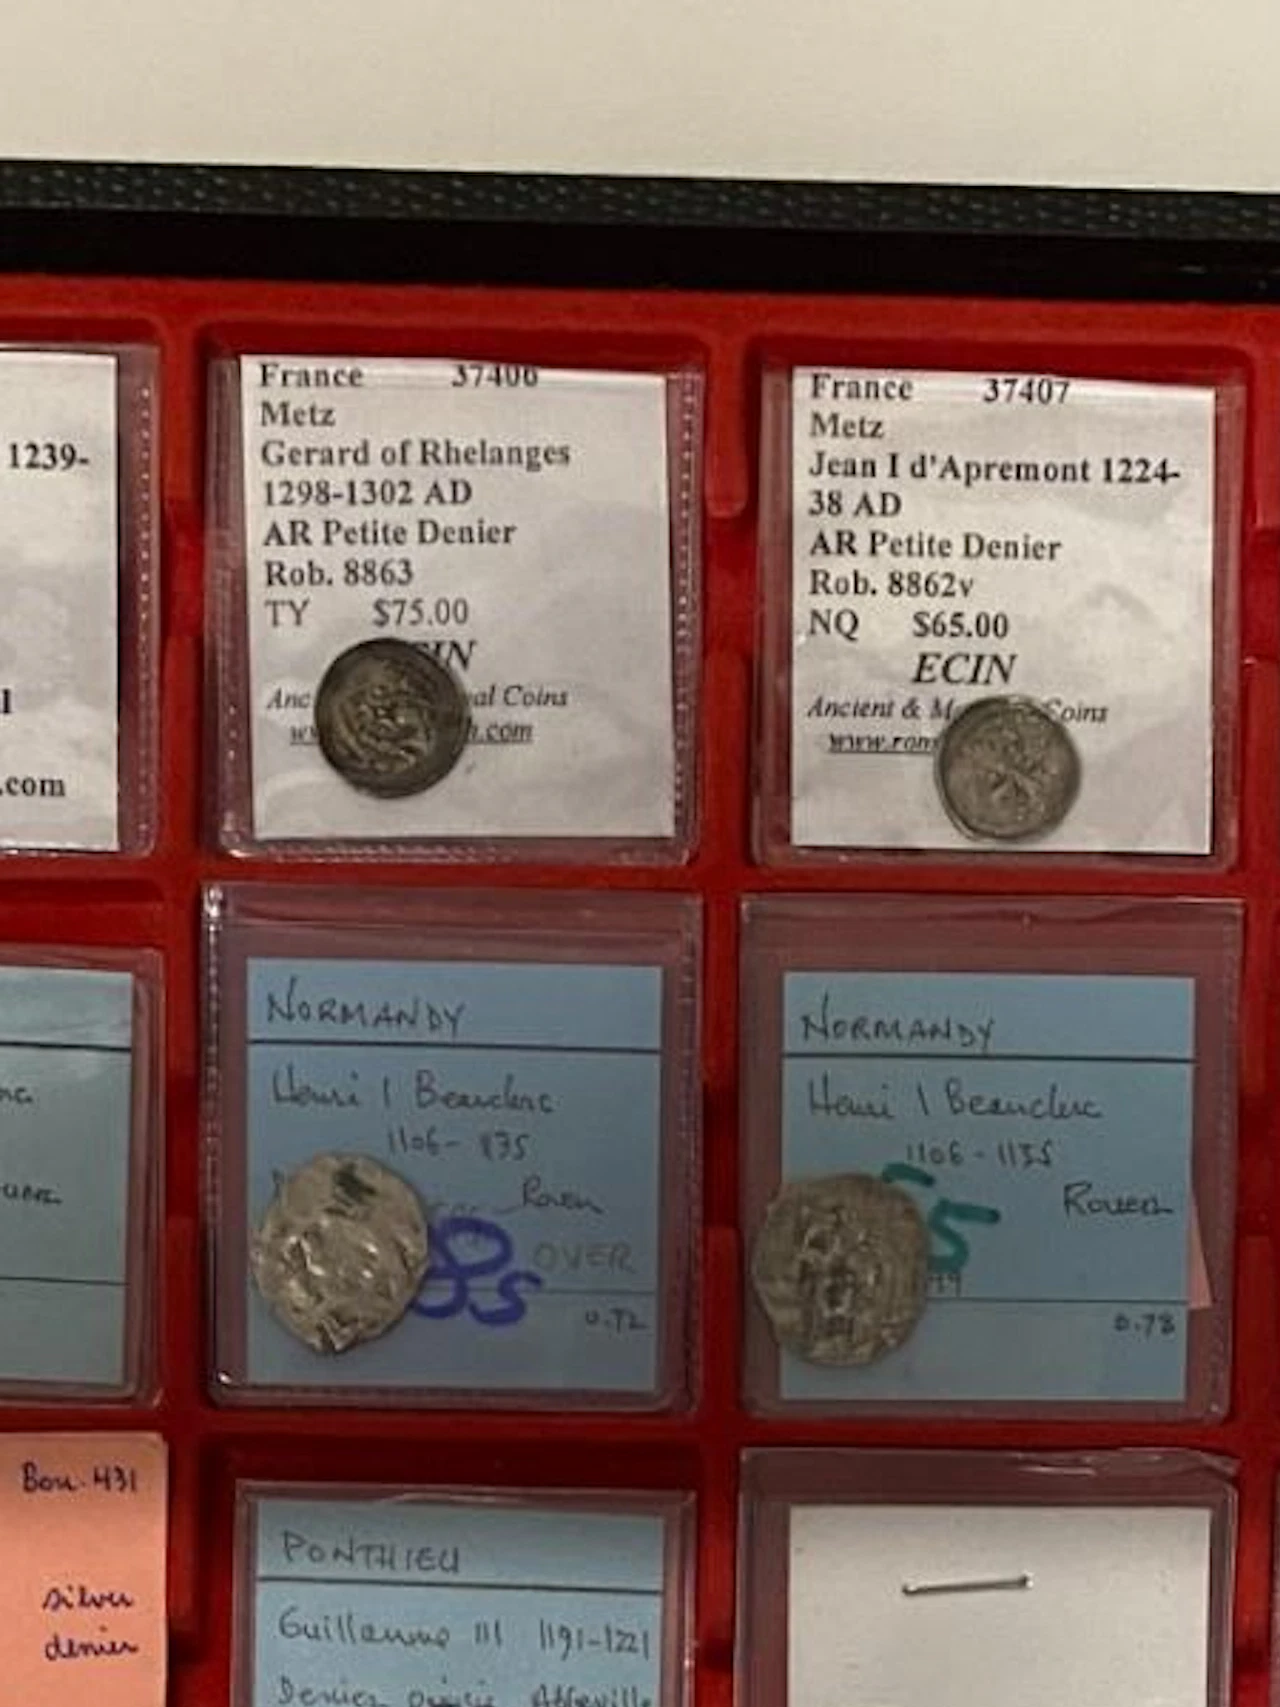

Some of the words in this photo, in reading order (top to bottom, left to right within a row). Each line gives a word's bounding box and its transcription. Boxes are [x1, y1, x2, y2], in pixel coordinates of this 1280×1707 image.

[808, 374, 914, 401] France
[983, 378, 1071, 403] 37407
[8, 443, 90, 470] 1239-
[261, 440, 370, 468] Gerard
[381, 440, 410, 465] of
[419, 441, 571, 472] Rhelanges
[808, 455, 877, 479] Jean
[888, 456, 899, 479] I
[909, 456, 1091, 488] d'Apremont
[1101, 458, 1180, 483] 1224-
[262, 481, 414, 506] 1298-1302
[424, 481, 473, 506] AD
[912, 653, 1017, 684] ECIN
[265, 976, 466, 1035] NORMANDY
[801, 992, 996, 1049] NORMANDY
[531, 1240, 636, 1274] OVER
[283, 1530, 461, 1573] PONTHIEU
